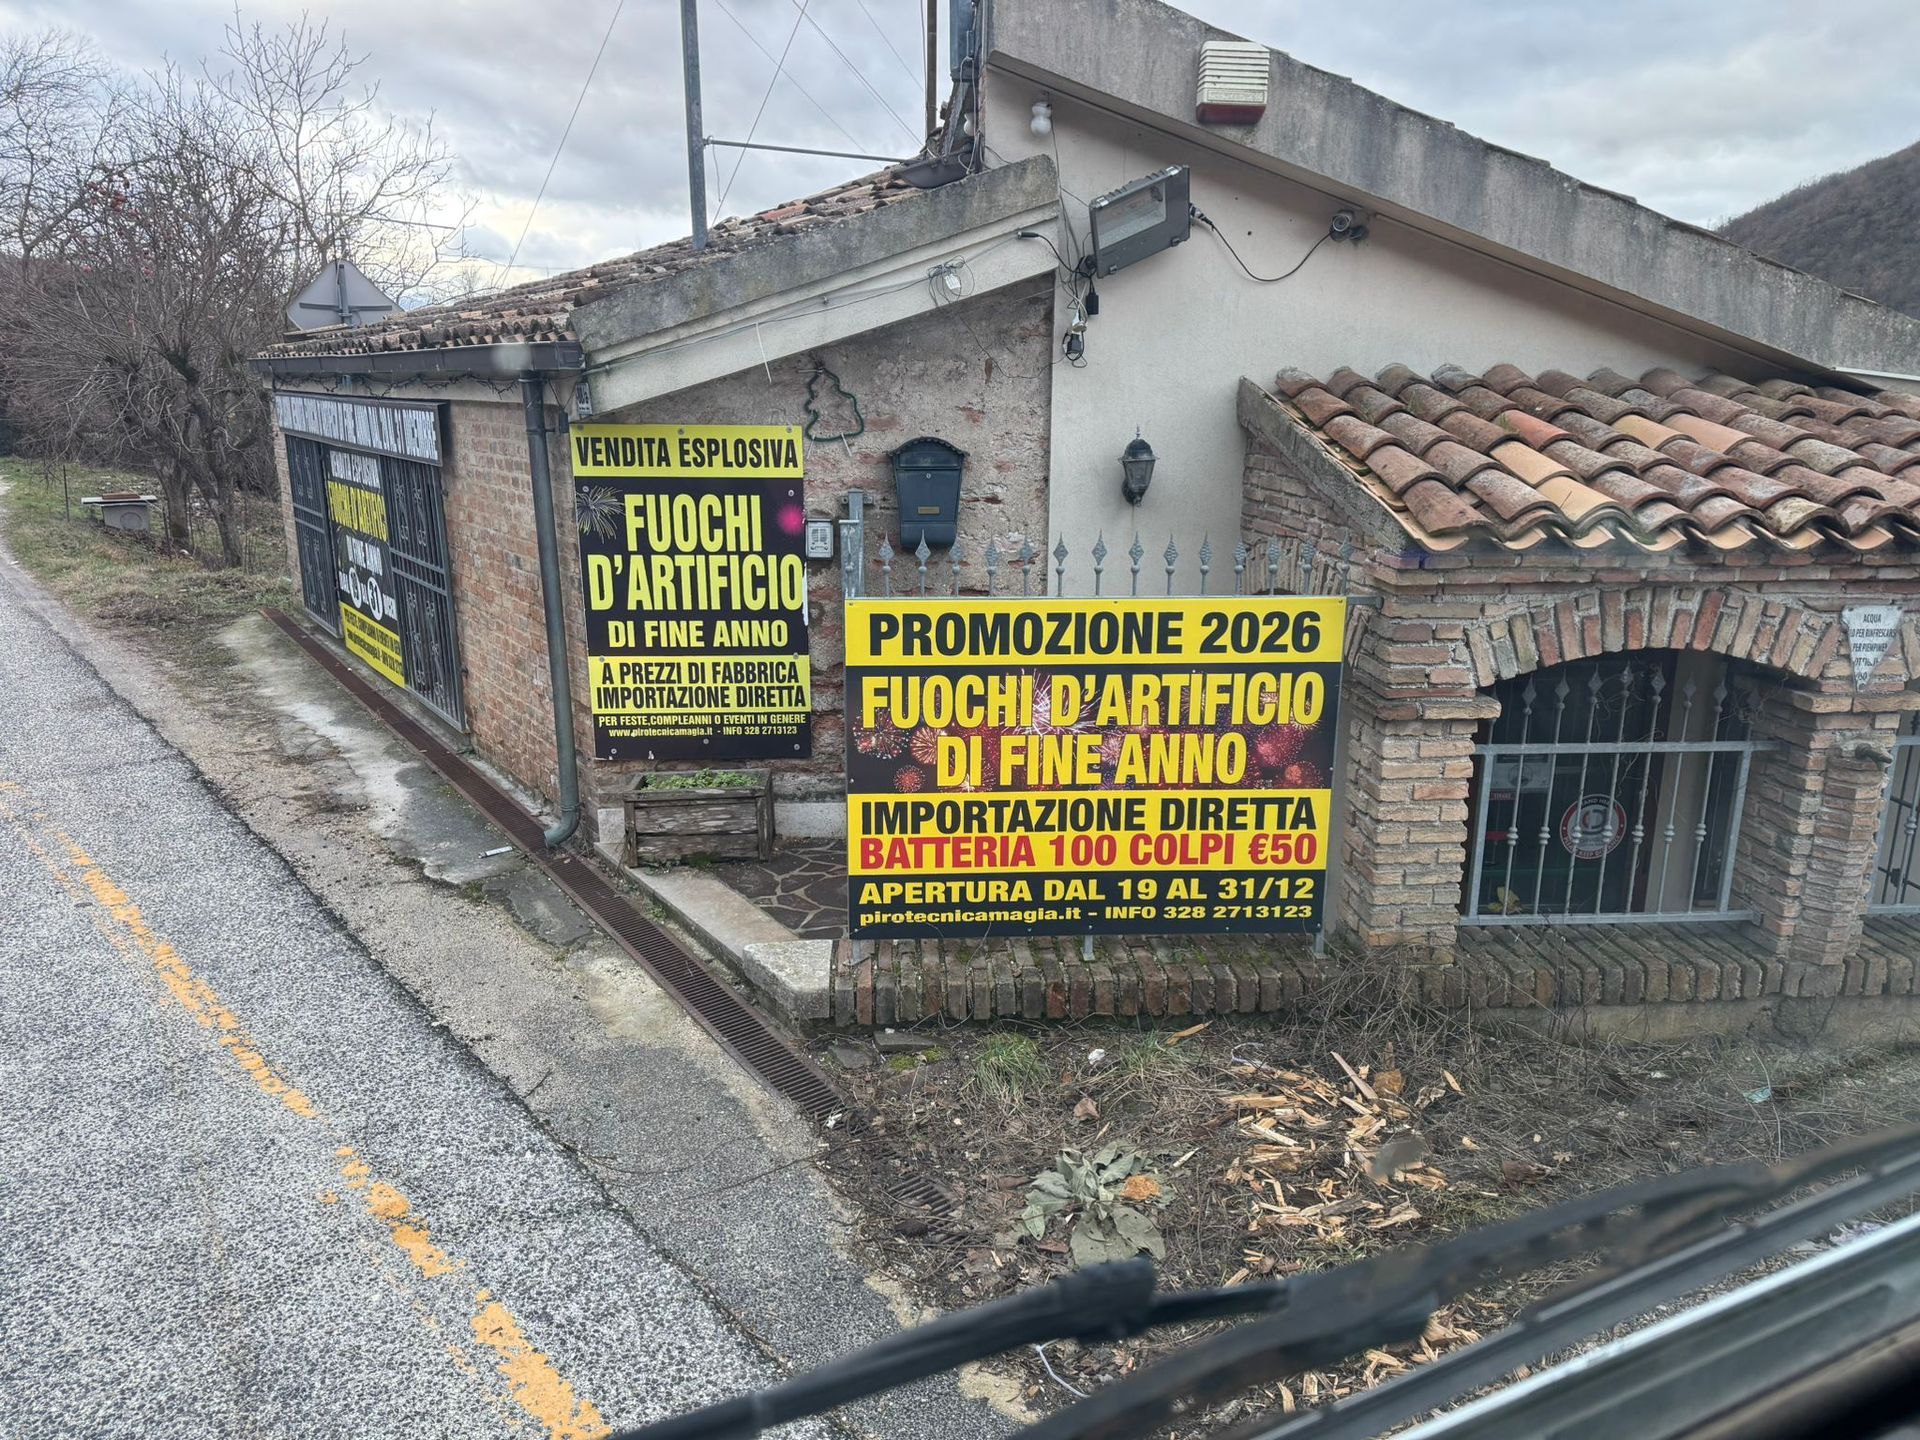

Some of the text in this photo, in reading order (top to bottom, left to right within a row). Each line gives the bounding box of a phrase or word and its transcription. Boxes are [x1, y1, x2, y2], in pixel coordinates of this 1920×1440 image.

[576, 437, 798, 468] VENDITA ESPLOSIVA
[624, 494, 762, 552] FUOCHI
[587, 554, 804, 611] D'ARTIFICIO
[608, 619, 788, 648] DI FINE ANNO
[869, 610, 1321, 656] PROMOZIONE 2026
[1863, 613, 1882, 624] ACQUA
[602, 661, 799, 684] A PREZZI DI FABBRICA
[596, 685, 806, 709] IMPORTAZIONE DIRETTA
[861, 671, 1325, 729] FUOCHI D'ARTIFICIO
[599, 716, 617, 726] PER
[714, 715, 721, 725] O
[724, 714, 755, 725] EVENTI
[757, 714, 767, 724] IN
[770, 713, 806, 724] GENERE
[609, 727, 713, 737] www.pirotecnicamagia.it
[723, 726, 742, 735] INFO
[744, 726, 760, 735] 328
[762, 725, 797, 735] 2713123
[936, 731, 1247, 787] DI FINE ANNO
[861, 797, 1316, 836] IMPORTAZIONE DIRETTA
[860, 832, 1317, 870] BATTERIA 100 COLPI €50
[859, 877, 1315, 905] APERTURA DAL 19 AL 31/12
[860, 907, 1082, 927] pirotecnicamagia.it
[1105, 906, 1156, 919] INFO
[1164, 906, 1206, 919] 328
[1212, 905, 1313, 918] 2713123
